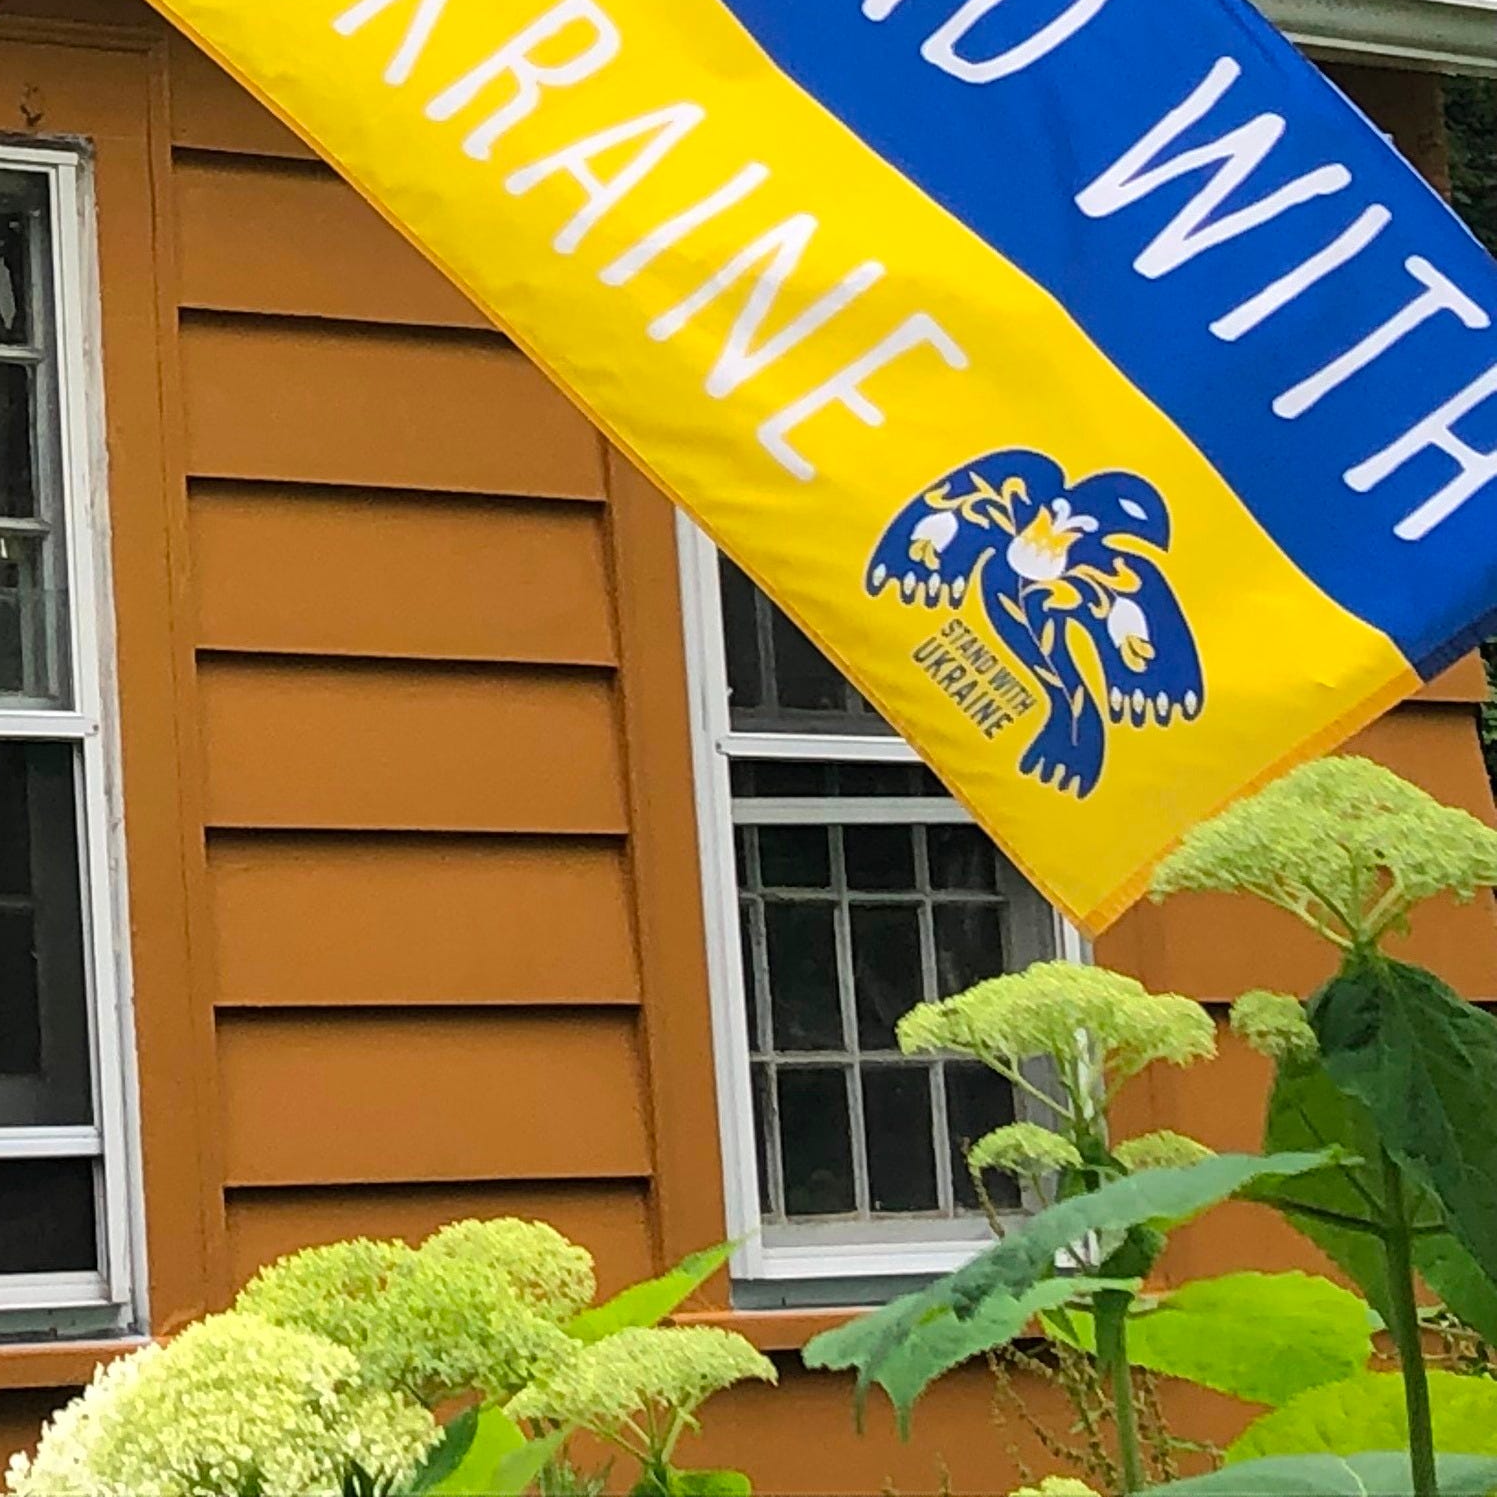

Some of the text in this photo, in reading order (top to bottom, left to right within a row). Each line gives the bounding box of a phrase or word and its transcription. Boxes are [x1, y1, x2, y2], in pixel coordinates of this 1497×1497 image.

[1074, 55, 1497, 542] WITH
[912, 636, 1014, 740] UKRAINE
[941, 618, 1037, 717] STAND WITH
